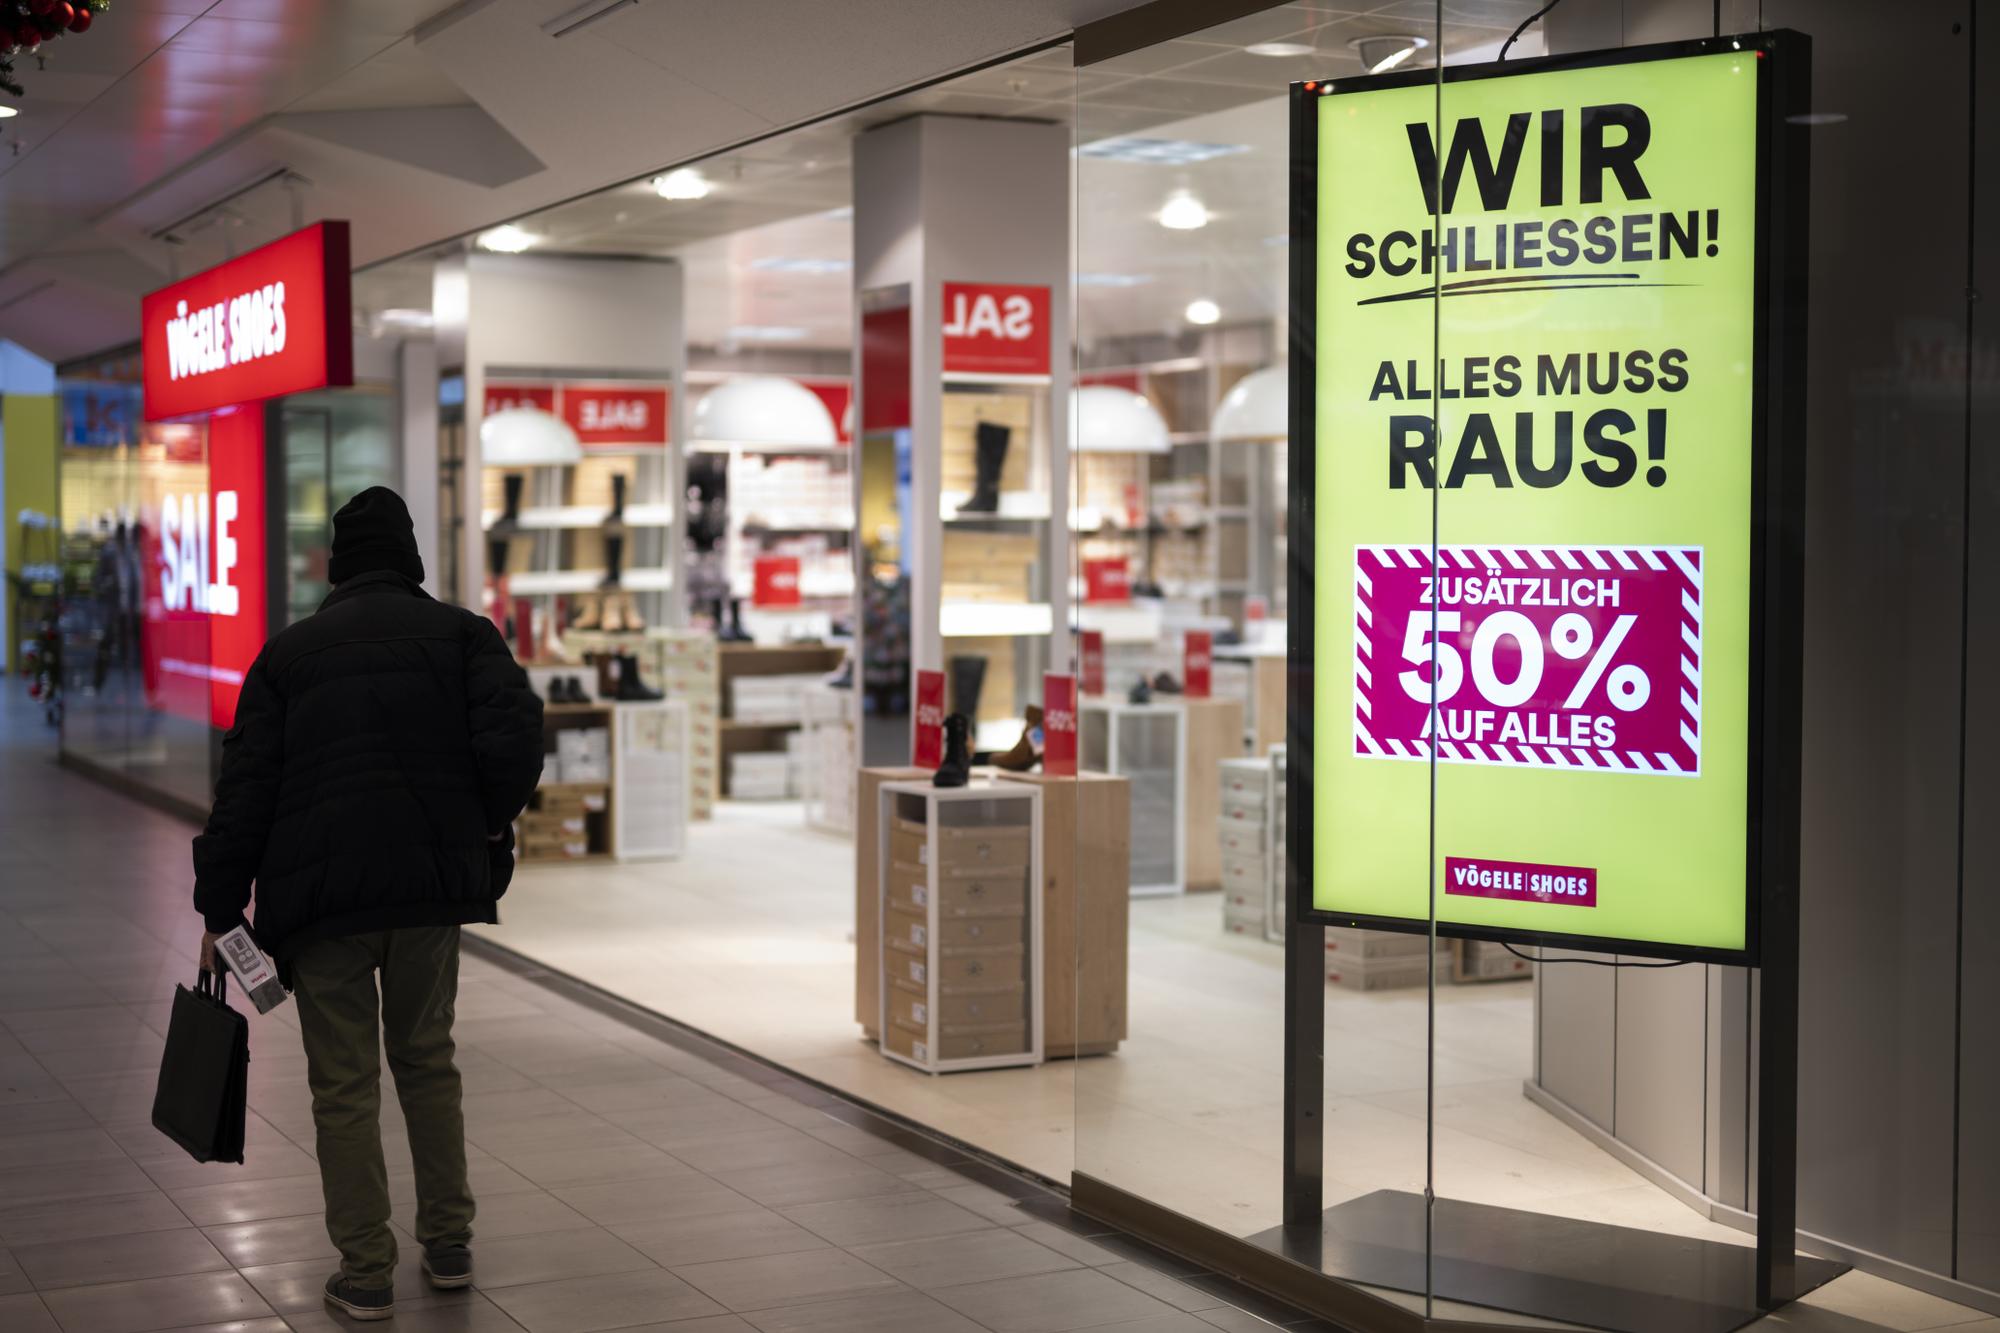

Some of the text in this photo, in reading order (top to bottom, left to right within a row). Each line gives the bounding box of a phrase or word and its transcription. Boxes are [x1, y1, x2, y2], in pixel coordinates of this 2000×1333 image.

[1405, 104, 1652, 214] WIR
[1345, 209, 1720, 279] SCHLIESSEN!
[229, 281, 287, 365] SHOES
[1369, 349, 1689, 401] ALLES MUSS
[1388, 409, 1667, 490] RAUS!
[160, 490, 240, 617] SALE
[1420, 569, 1620, 607] ZUSÄTZLICH
[1398, 610, 1651, 712] 50%
[1420, 708, 1617, 748] AUF ALLES
[1530, 873, 1588, 896] SHOES
